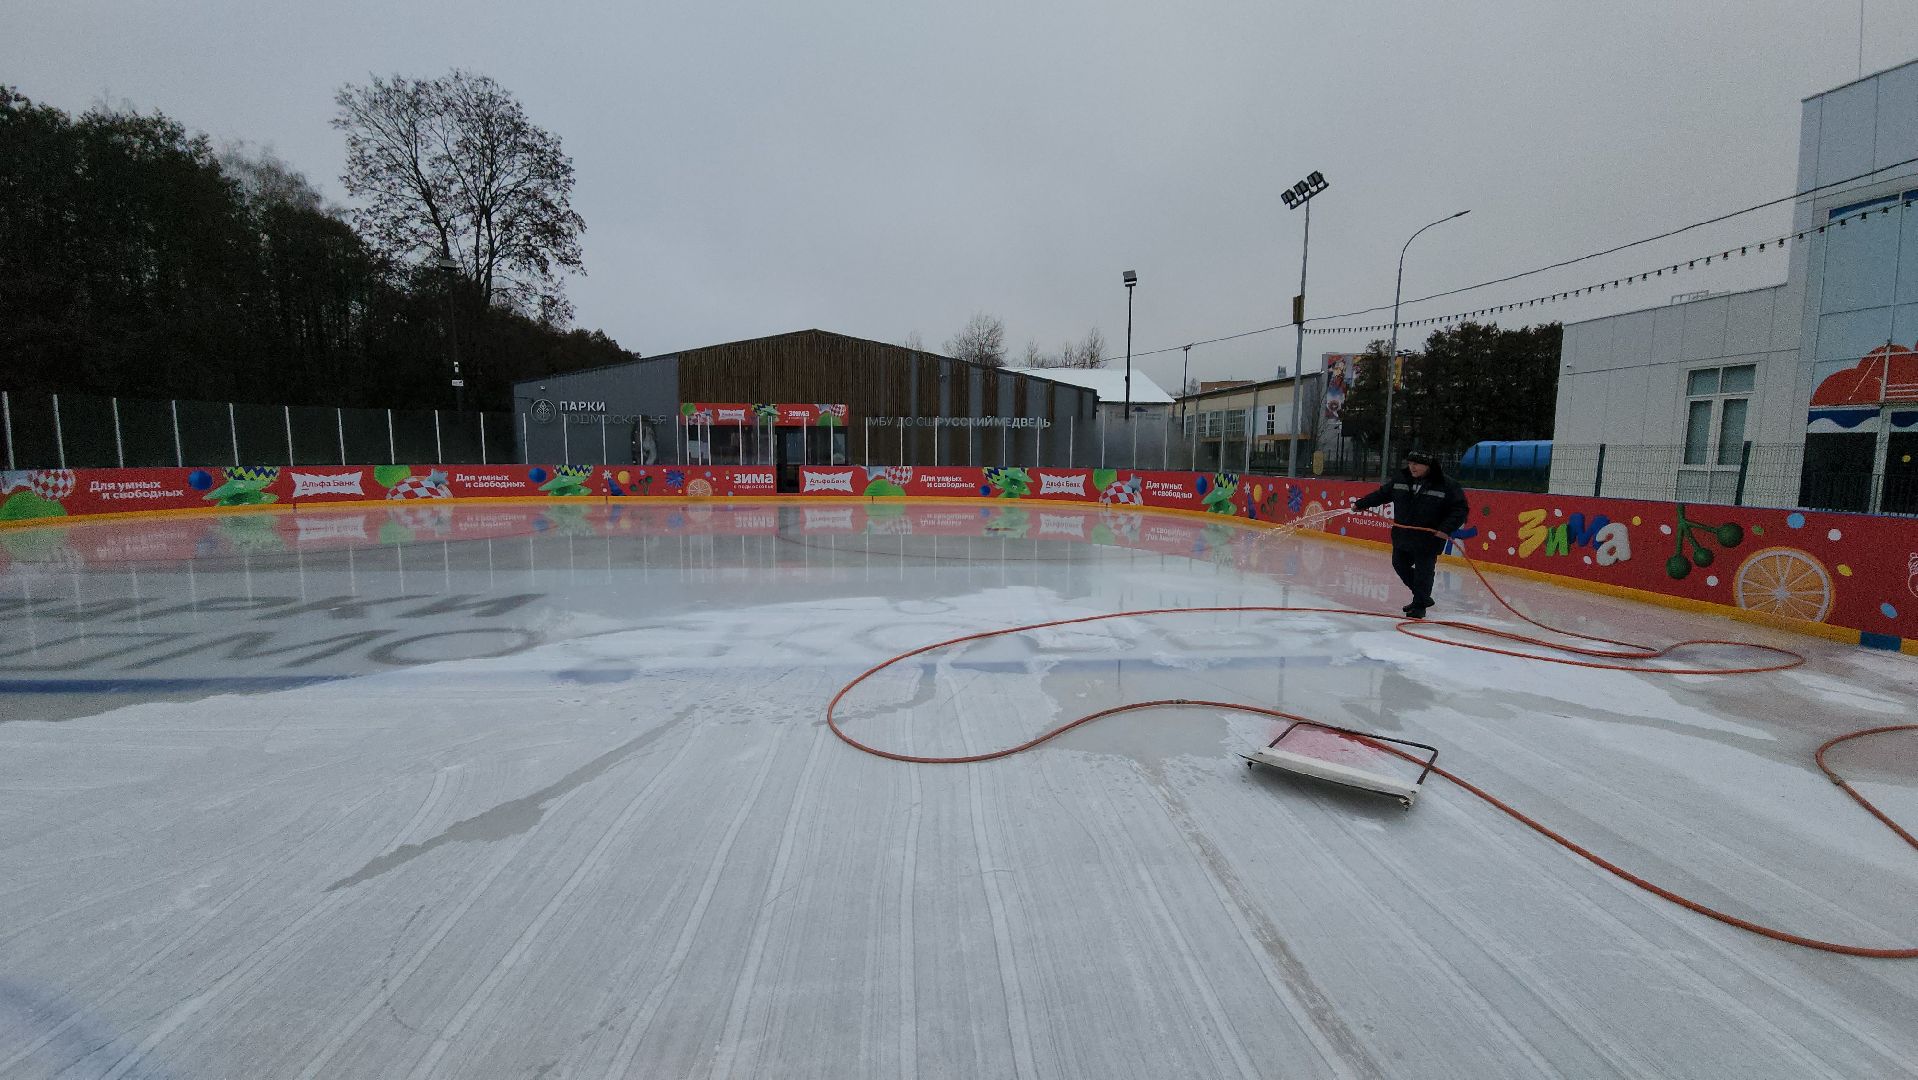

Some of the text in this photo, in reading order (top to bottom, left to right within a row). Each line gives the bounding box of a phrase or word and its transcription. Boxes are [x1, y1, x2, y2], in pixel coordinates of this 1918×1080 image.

[560, 400, 606, 412] ПАРКИ
[868, 416, 894, 427] МБУ
[897, 416, 913, 429] ДО
[456, 473, 476, 482] Для
[920, 474, 936, 483] Для
[90, 481, 161, 493] Для умных
[301, 480, 332, 490] Альфа
[473, 481, 526, 489] свободных
[1145, 480, 1183, 491] Для умных
[102, 489, 184, 500] и свободных
